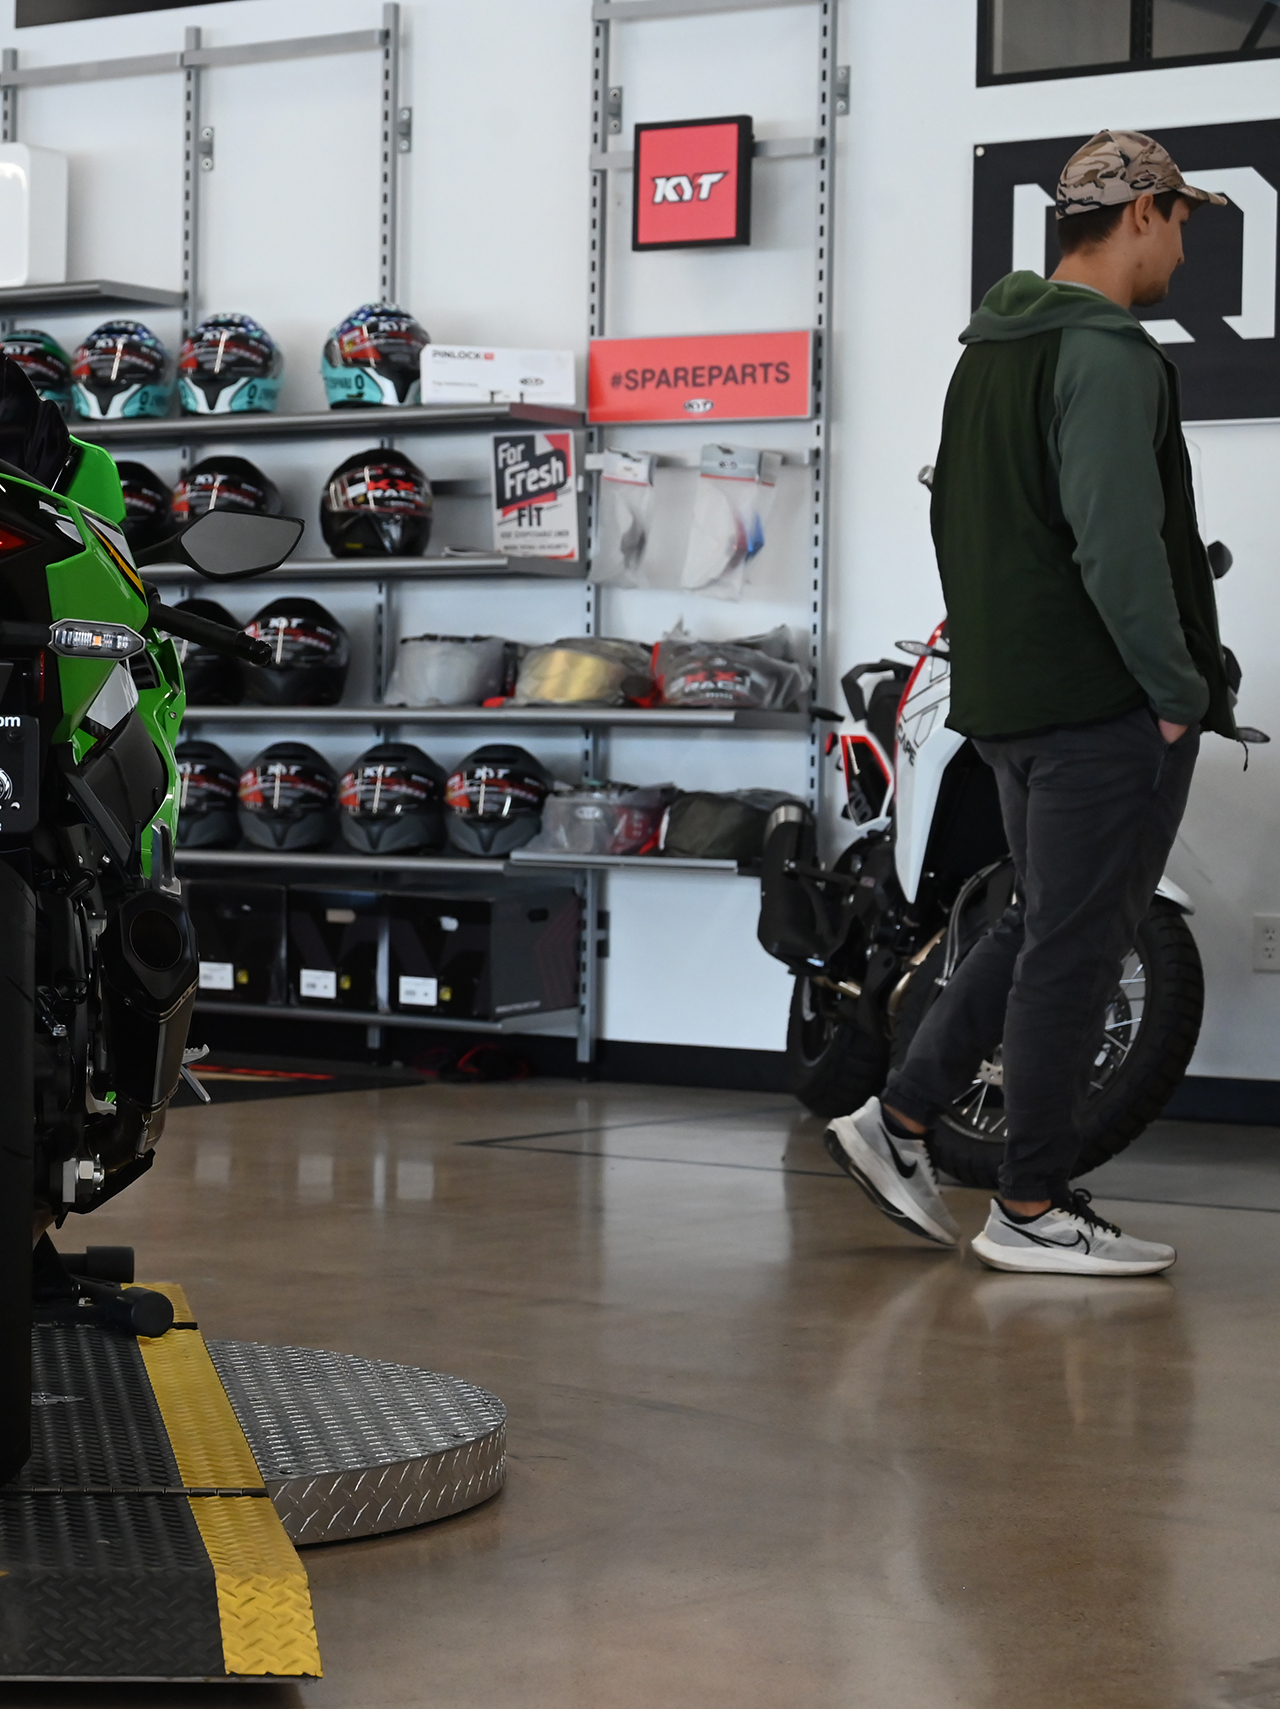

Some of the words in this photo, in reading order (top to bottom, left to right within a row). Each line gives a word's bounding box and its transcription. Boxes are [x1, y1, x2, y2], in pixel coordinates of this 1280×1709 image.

[651, 171, 728, 205] KYT
[610, 361, 791, 391] #SPAREPARTS
[497, 441, 526, 469] For
[504, 456, 566, 499] Fresh
[516, 504, 544, 527] FIT
